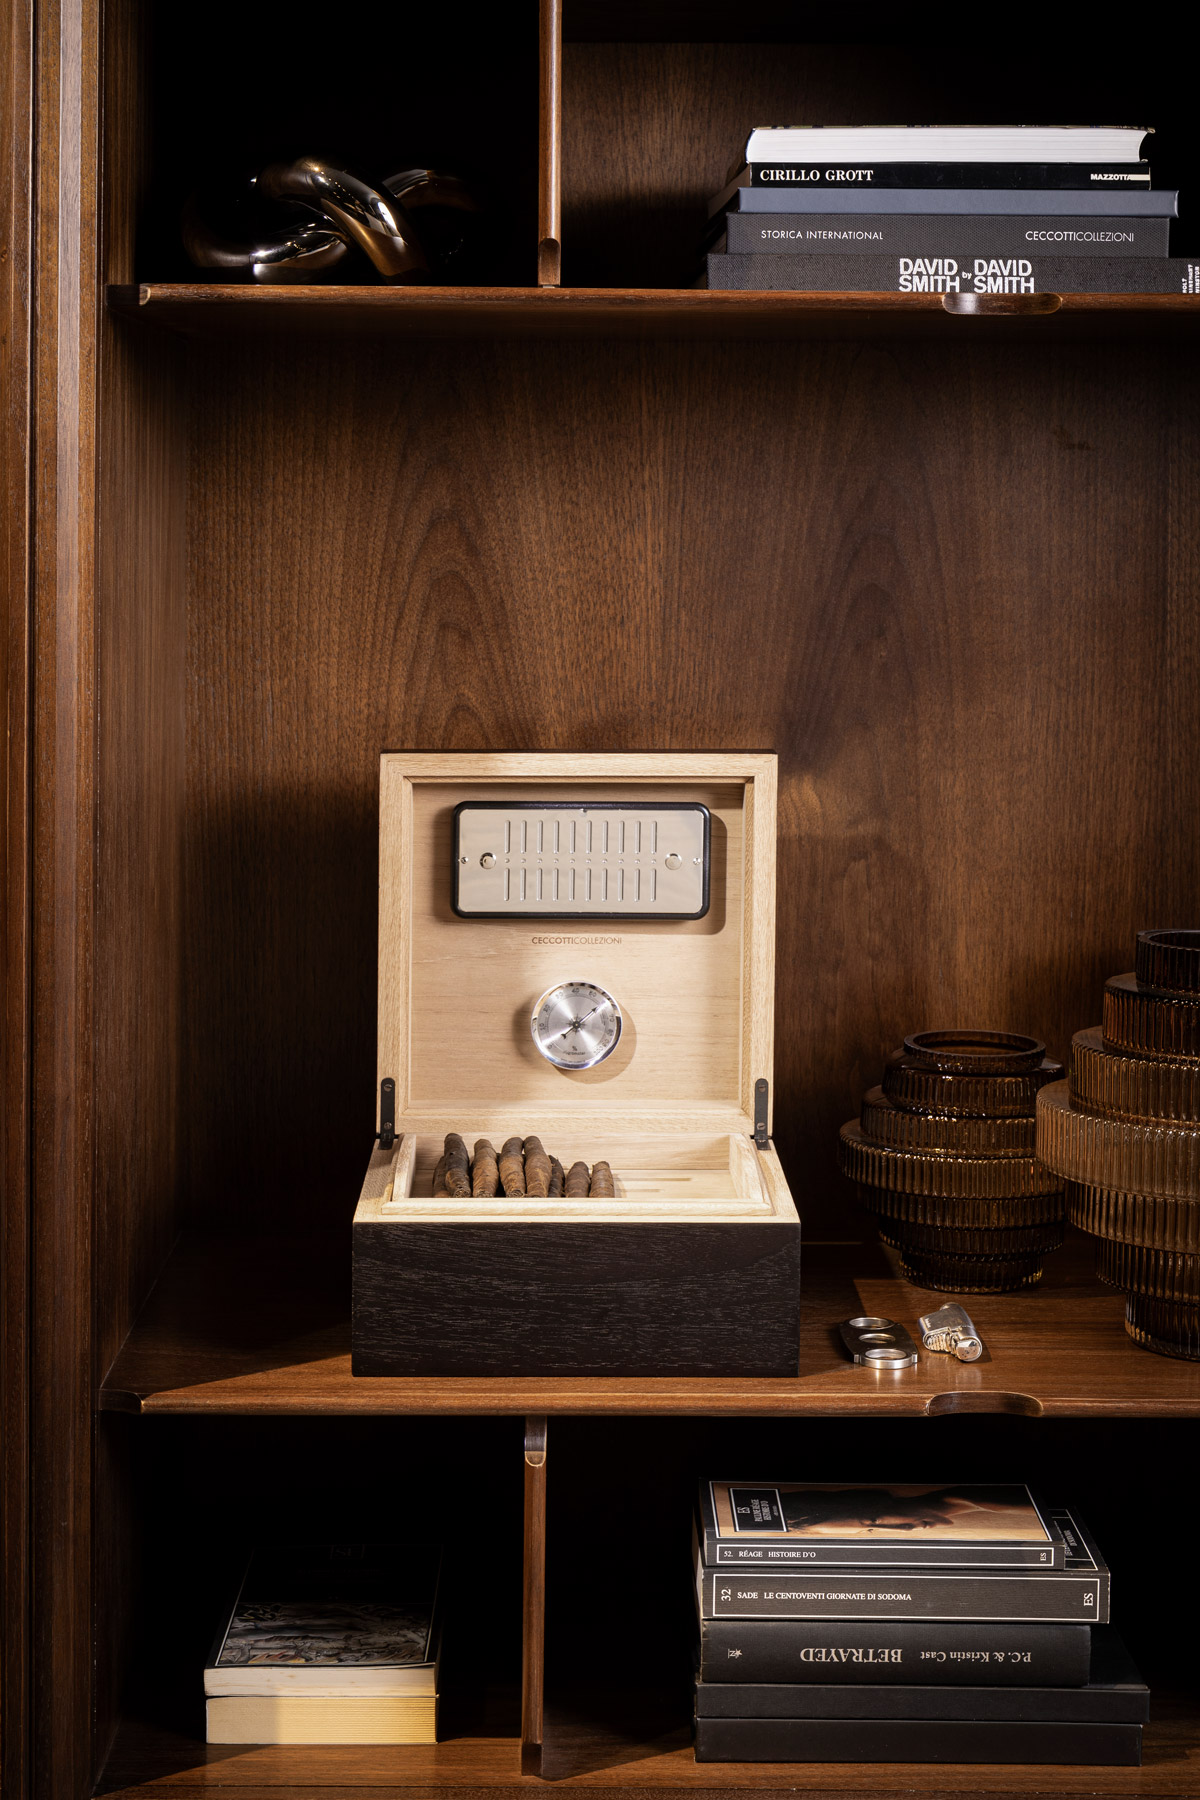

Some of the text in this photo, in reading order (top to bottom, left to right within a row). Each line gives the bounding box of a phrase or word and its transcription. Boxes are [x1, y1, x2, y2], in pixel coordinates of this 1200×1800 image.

[759, 169, 874, 181] CIRILLO GROTT
[1090, 173, 1131, 181] MAZZOTTA
[760, 229, 884, 241] STORICA INTERNATIONAL
[1024, 230, 1135, 242] CECCOTTICOLLEZIONI
[899, 258, 958, 275] DAVID
[973, 259, 1032, 276] DAVID
[961, 271, 972, 279] by
[898, 275, 960, 292] SMITH
[973, 276, 1035, 293] SMITH
[531, 936, 622, 945] CECCOTTICOLLEZIONI
[738, 1550, 763, 1558] RÉAGE
[737, 1591, 912, 1601] SADE LE CENTOVENTI GIORNATE DI SODOMA
[1083, 1592, 1094, 1607] ES
[799, 1647, 903, 1663] BETRAYED
[920, 1651, 1032, 1662] P.C. & Kristin Cast
